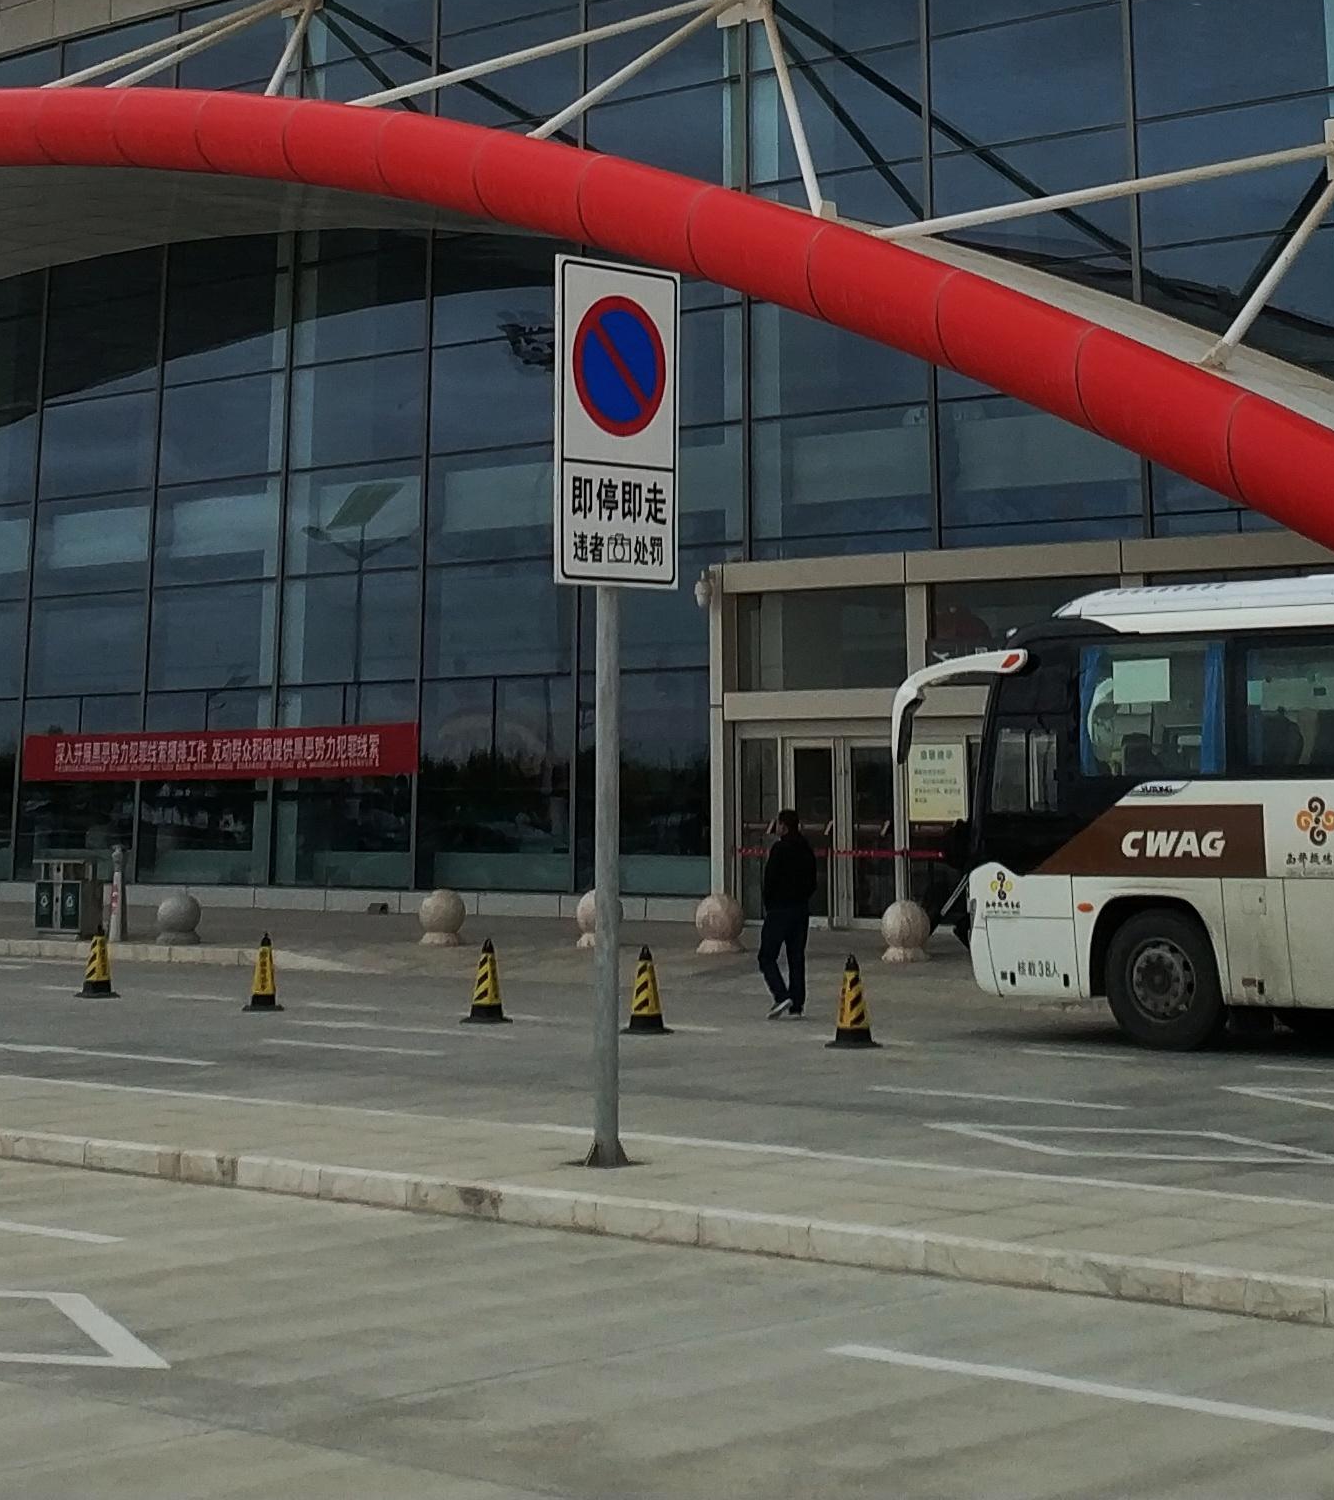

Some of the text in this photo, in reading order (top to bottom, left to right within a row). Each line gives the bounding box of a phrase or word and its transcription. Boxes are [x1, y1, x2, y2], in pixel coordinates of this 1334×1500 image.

[571, 475, 667, 525] 即停即走
[573, 531, 664, 567] 违者 处罚
[1121, 831, 1226, 858] CWAG
